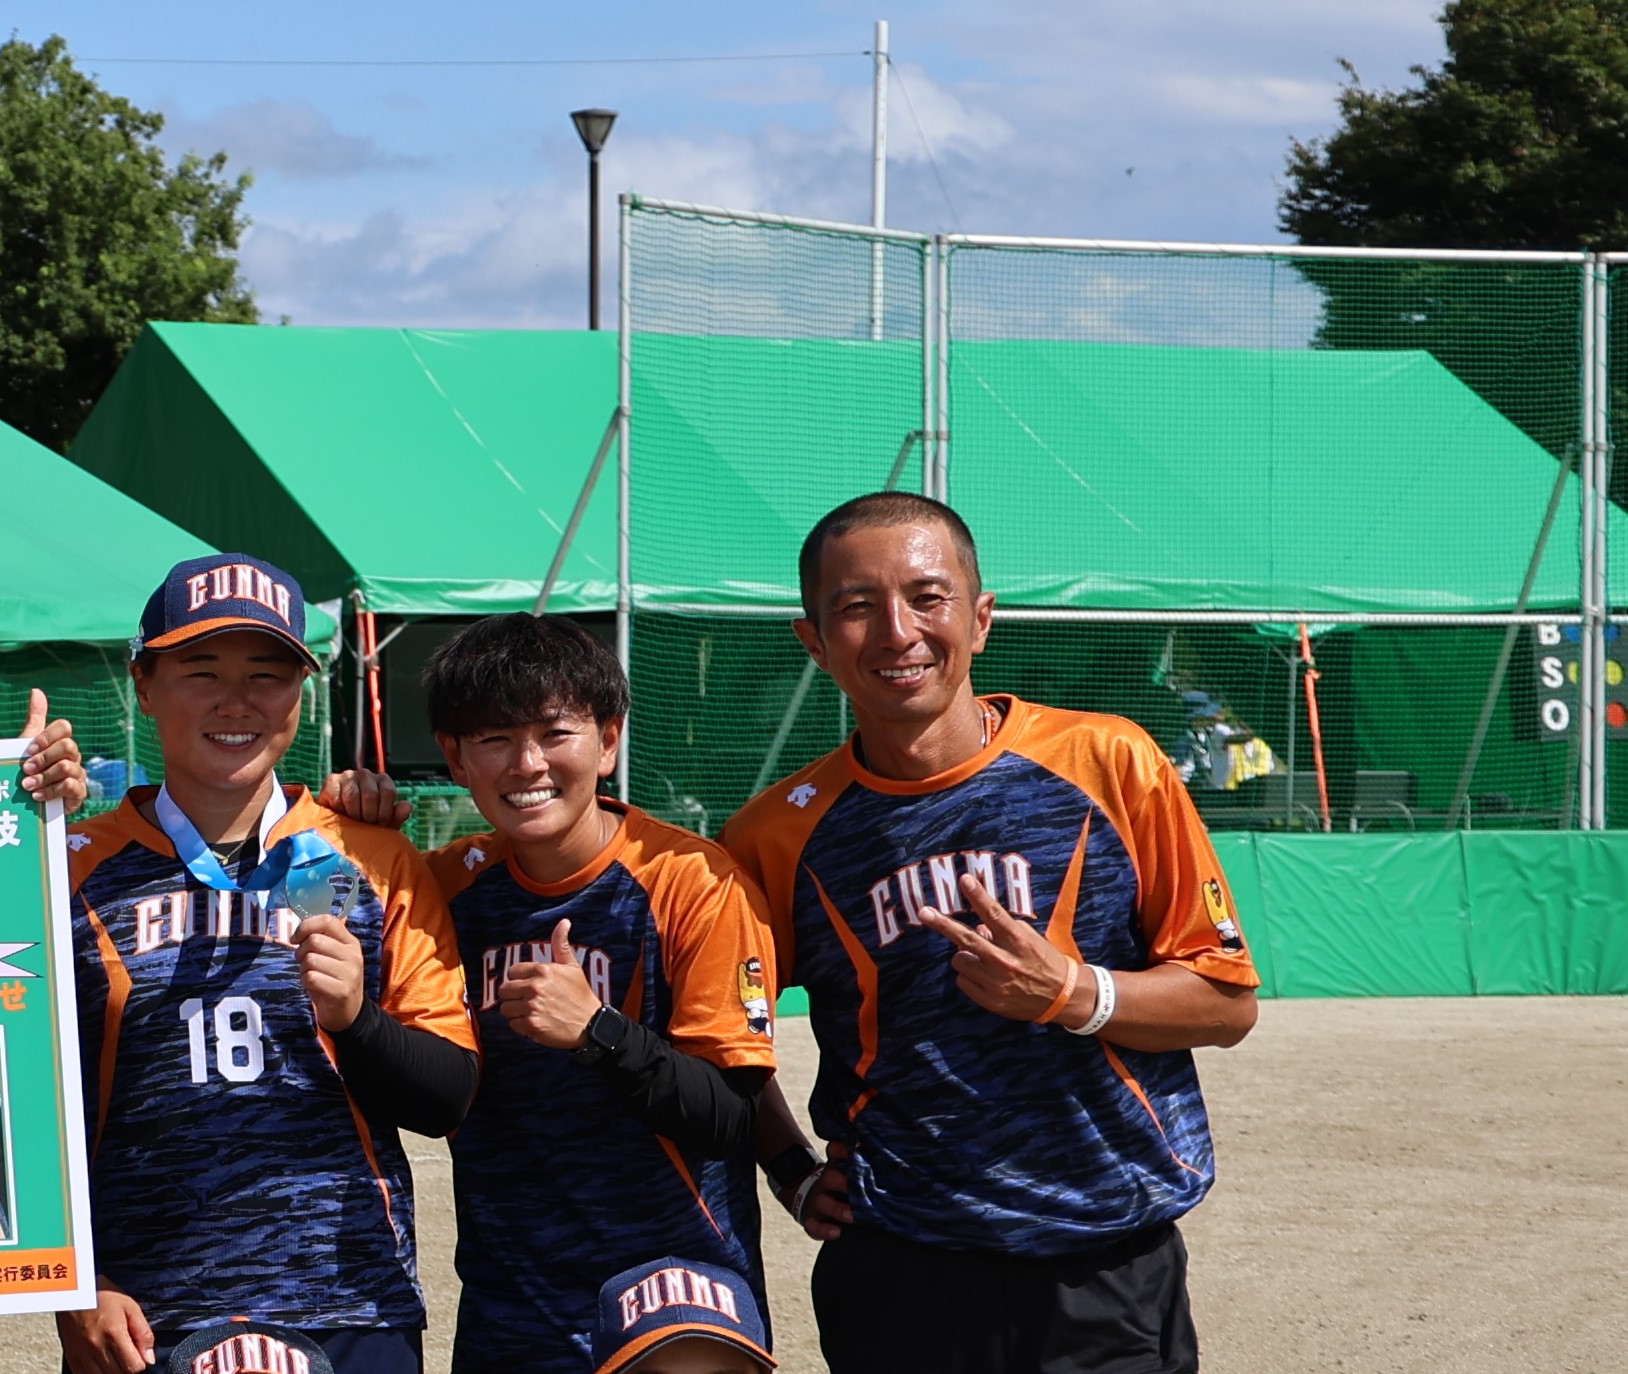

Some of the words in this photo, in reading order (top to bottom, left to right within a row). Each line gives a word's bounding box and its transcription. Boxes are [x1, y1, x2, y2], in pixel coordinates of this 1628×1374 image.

[187, 563, 293, 628] GUNMA
[1536, 624, 1561, 645] B
[1541, 658, 1564, 688] S
[1543, 700, 1569, 731] O
[179, 996, 264, 1085] 18
[618, 1267, 741, 1332] GUNMA
